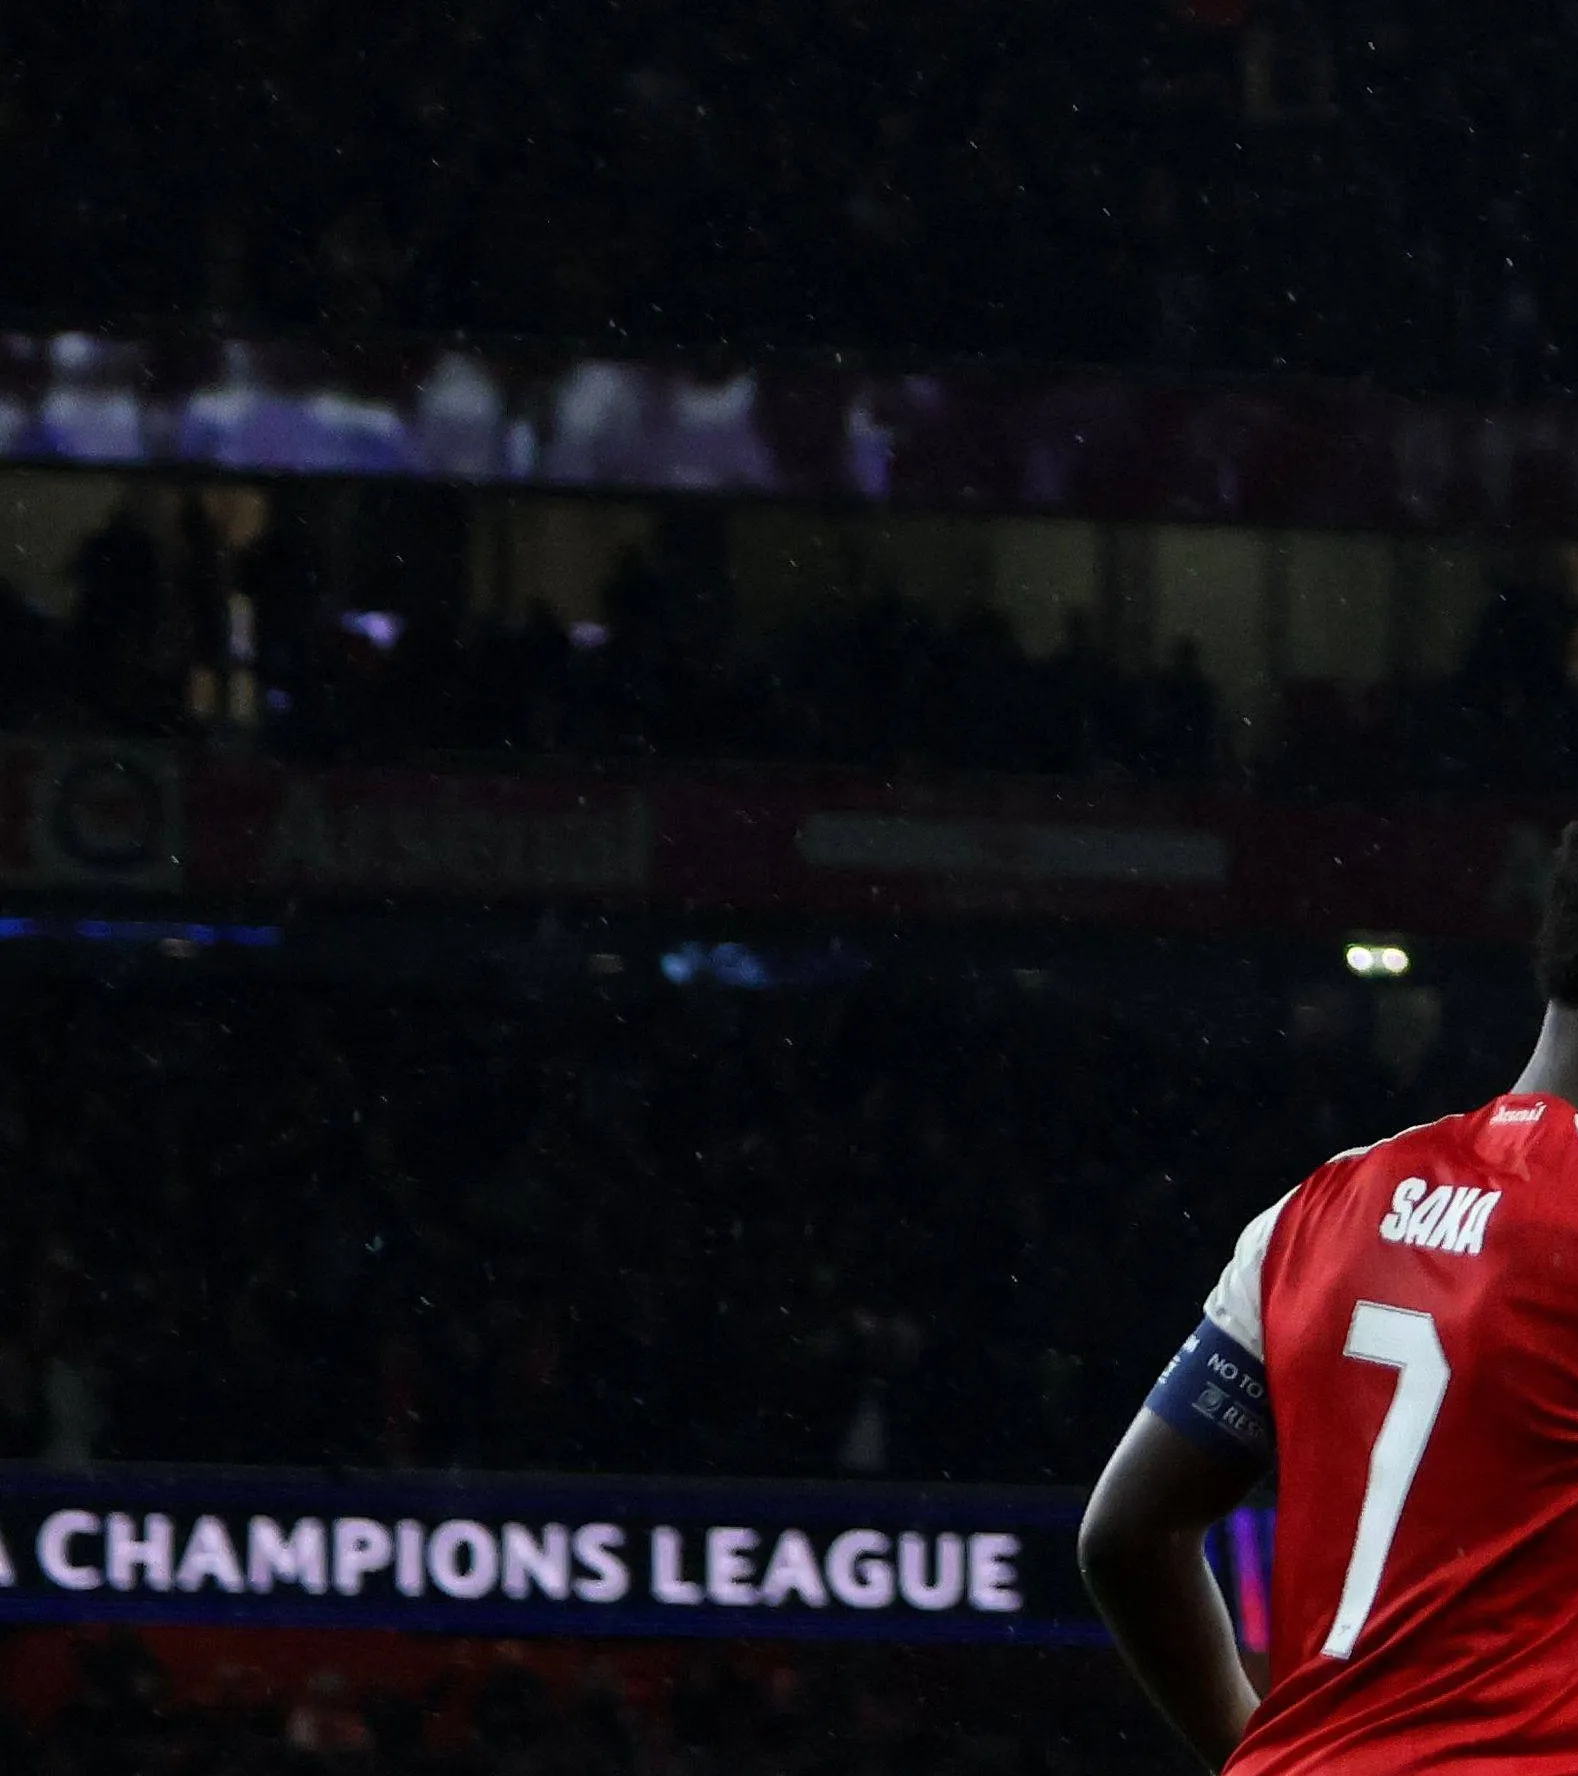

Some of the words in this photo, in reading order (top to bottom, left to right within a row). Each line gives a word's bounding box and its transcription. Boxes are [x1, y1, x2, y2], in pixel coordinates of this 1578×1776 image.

[1379, 1177, 1502, 1256] SAKA
[1206, 1353, 1239, 1380] NO
[1239, 1373, 1264, 1399] TO
[1324, 1300, 1450, 1659] 7
[38, 1509, 630, 1602] CHAMPIONS
[649, 1525, 1024, 1612] LEAGUE
